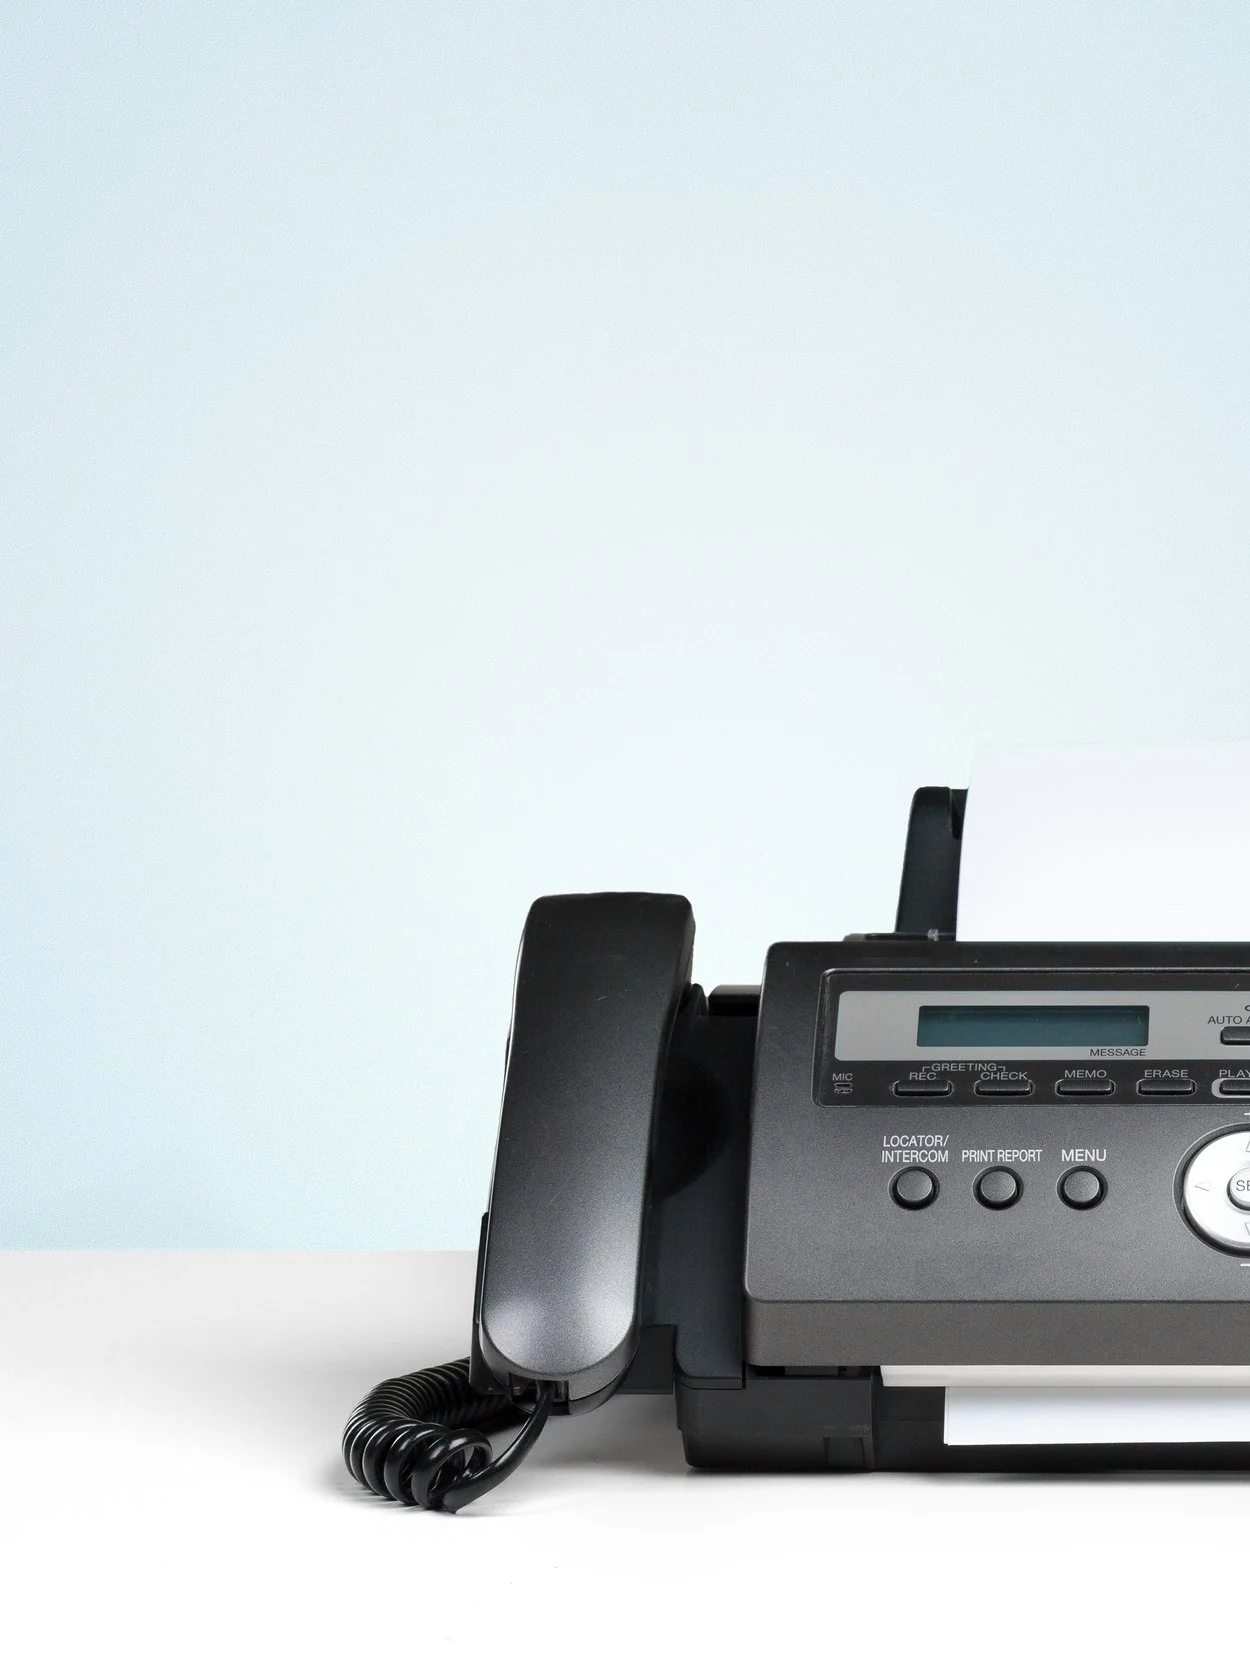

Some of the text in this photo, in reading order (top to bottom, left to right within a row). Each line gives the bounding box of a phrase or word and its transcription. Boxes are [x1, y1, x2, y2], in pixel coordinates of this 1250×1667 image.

[1208, 1015, 1242, 1025] AUTO
[1090, 1048, 1146, 1057] MESSAGE
[931, 1063, 997, 1071] GREETING
[832, 1073, 853, 1081] MIC
[909, 1072, 936, 1081] REC
[980, 1071, 1028, 1080] CHECK
[1064, 1069, 1107, 1078] MEMO
[1144, 1069, 1189, 1078] ERASE
[883, 1135, 949, 1149] LOCATOR/
[882, 1150, 949, 1162] INTERCOM
[962, 1150, 1042, 1162] PRINT REPORT
[1061, 1150, 1106, 1162] MENU
